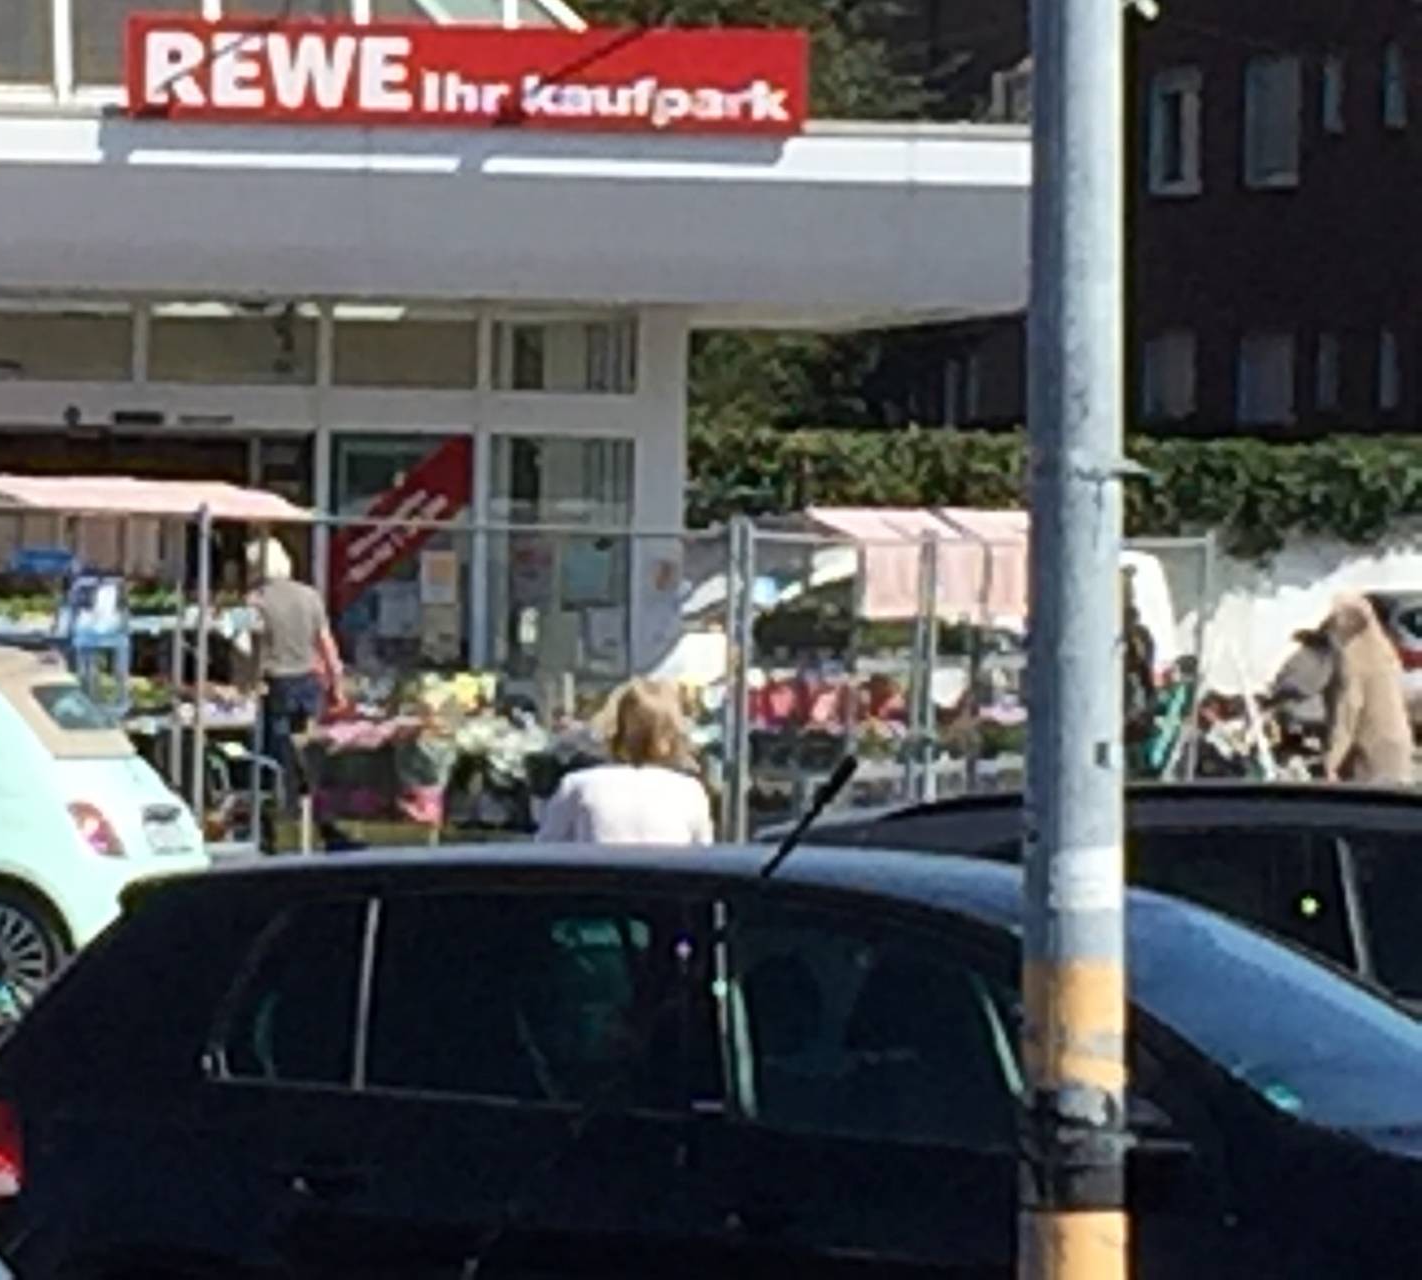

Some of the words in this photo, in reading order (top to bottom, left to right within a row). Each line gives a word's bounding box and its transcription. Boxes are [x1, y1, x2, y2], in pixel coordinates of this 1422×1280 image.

[145, 31, 413, 111] REWE
[421, 72, 510, 114] Ihr
[522, 76, 789, 126] kaufpark
